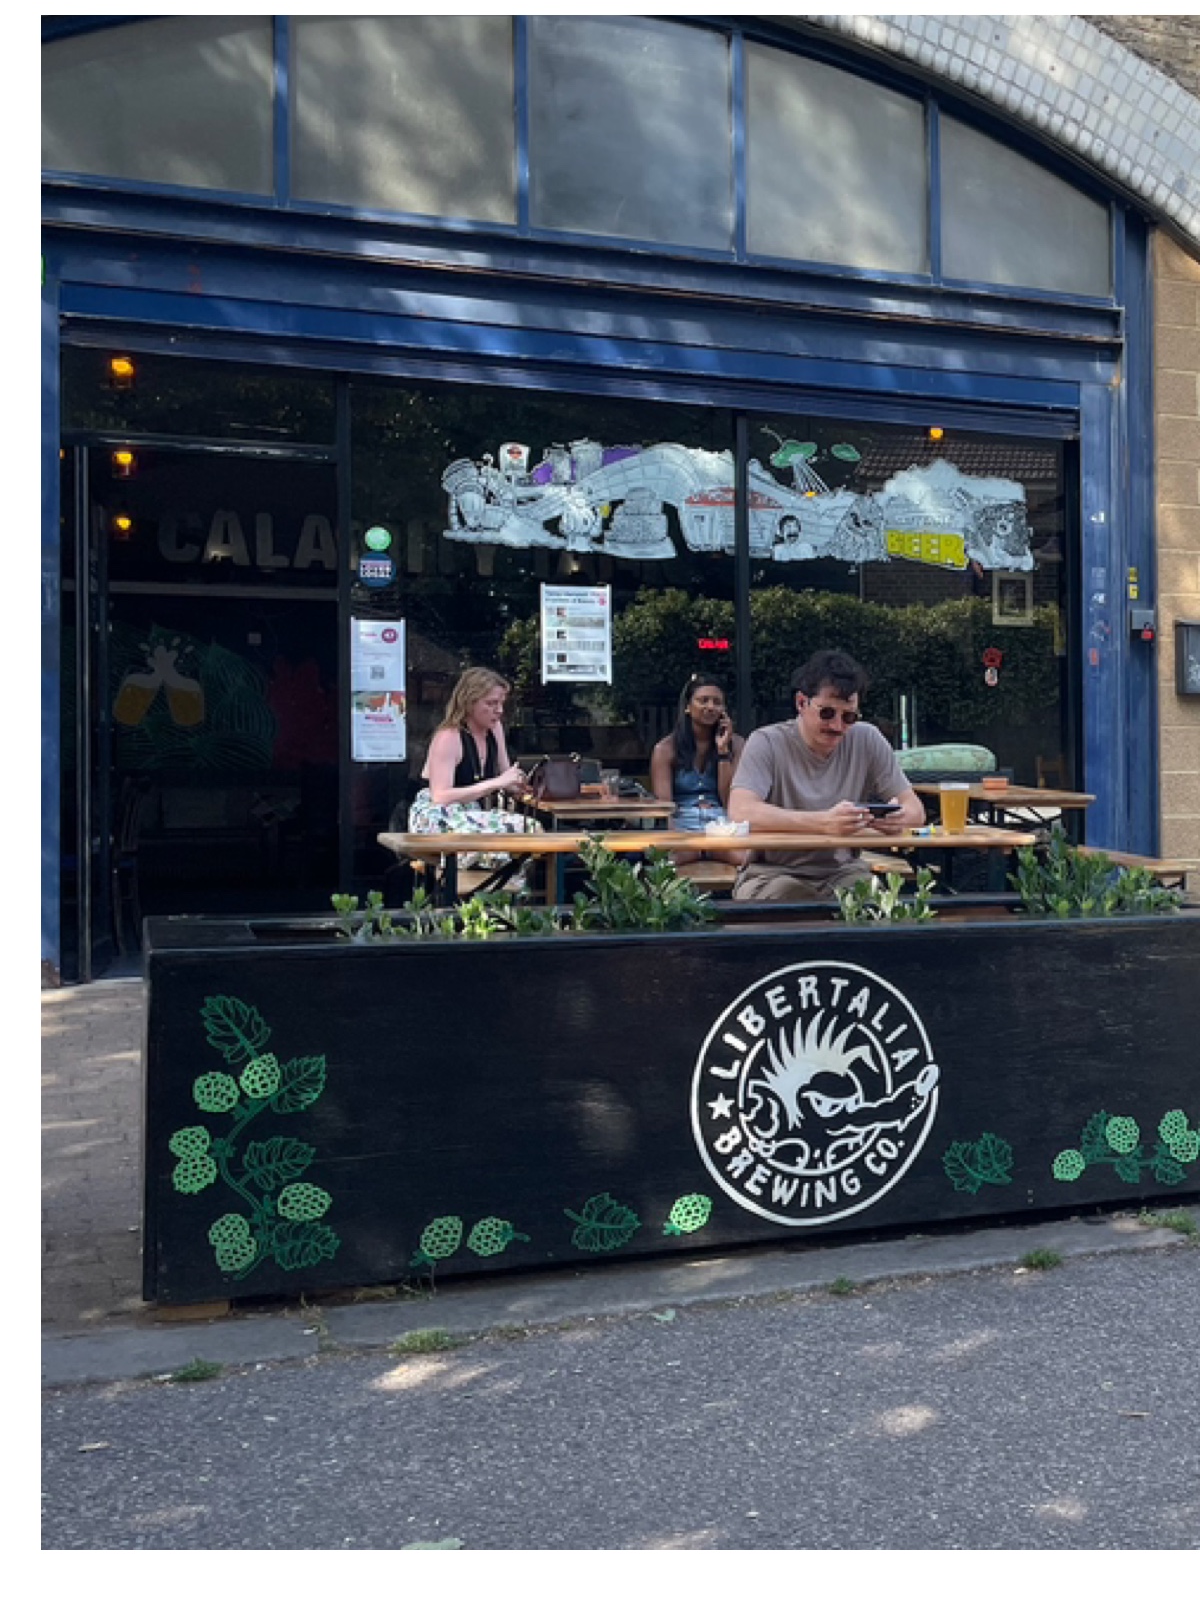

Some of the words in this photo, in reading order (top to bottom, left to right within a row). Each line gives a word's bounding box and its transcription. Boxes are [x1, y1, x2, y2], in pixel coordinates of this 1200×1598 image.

[887, 529, 968, 569] BEER
[708, 974, 920, 1081] LIBERTALIA
[713, 1125, 862, 1208] BREWING
[863, 1138, 905, 1177] CO.
